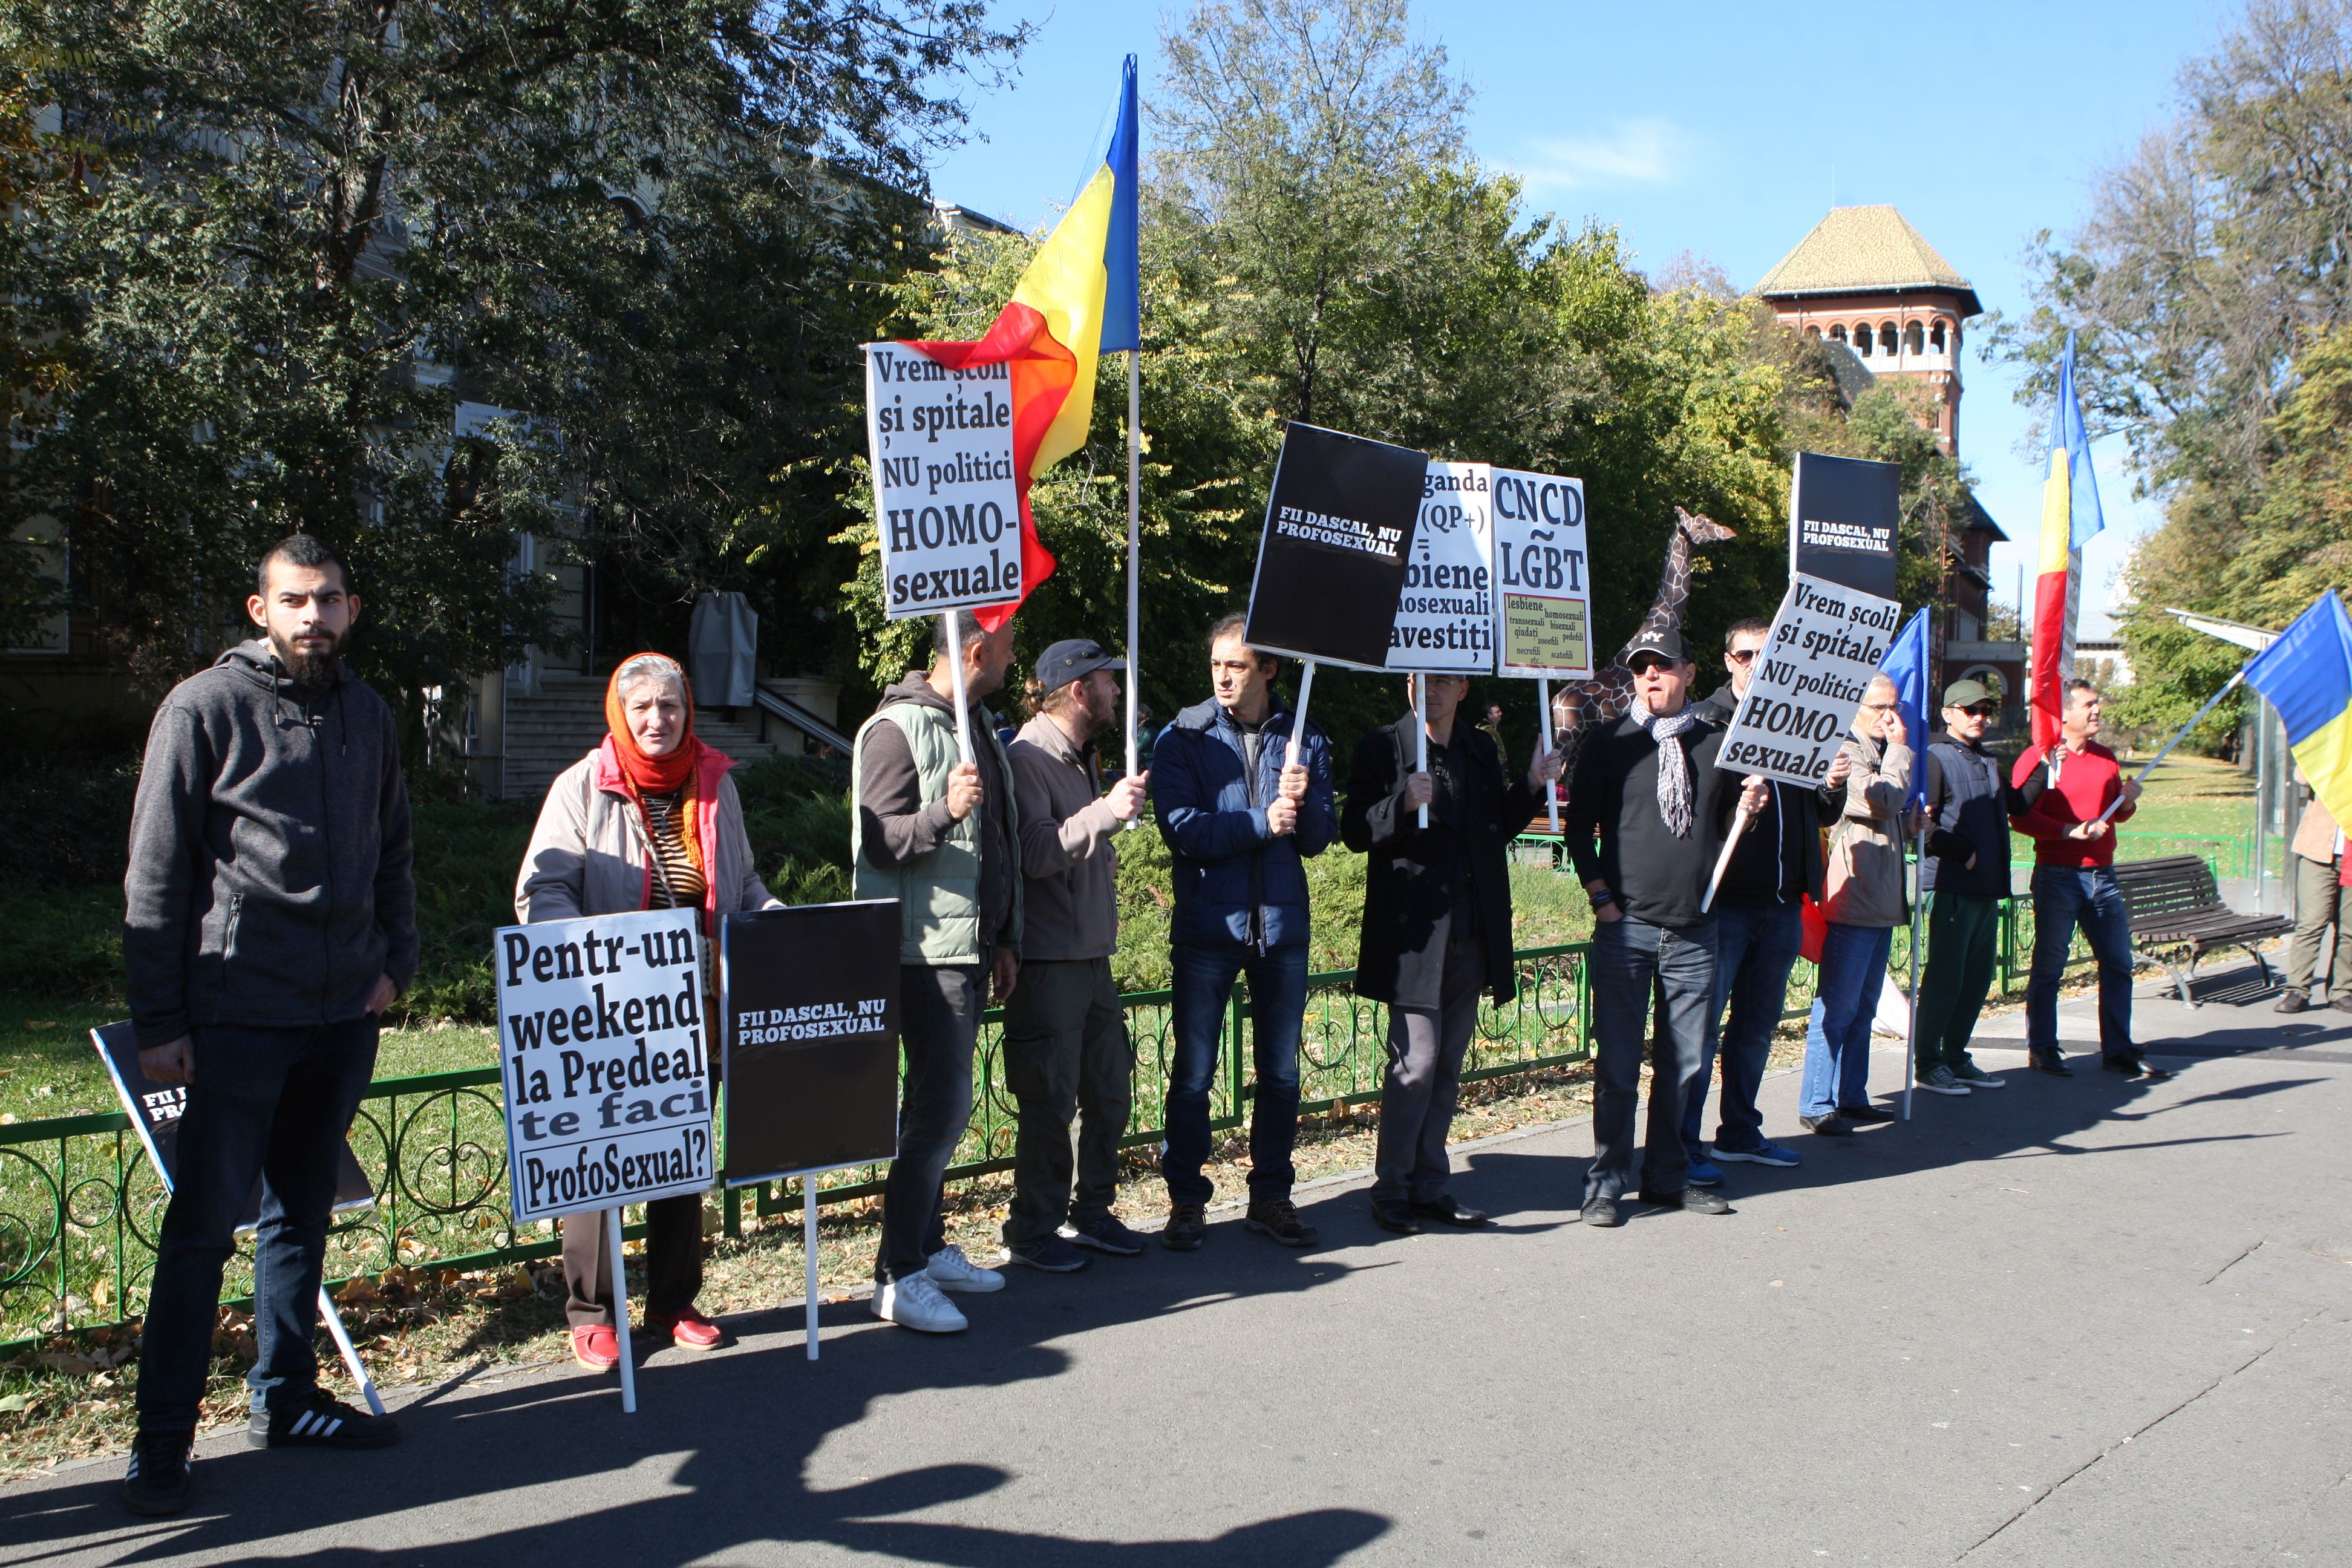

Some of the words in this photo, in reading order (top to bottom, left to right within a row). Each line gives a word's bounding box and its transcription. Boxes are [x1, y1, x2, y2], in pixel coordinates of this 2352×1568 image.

[874, 351, 947, 383] Vrem
[879, 394, 905, 449] și
[913, 391, 1010, 443] spitale
[882, 456, 920, 488] NU
[927, 449, 1013, 495] politici
[1495, 476, 1583, 527] CNCD
[887, 501, 1018, 553] HOMO-
[1276, 520, 1397, 557] PROFOSEXUAL
[1279, 506, 1303, 522] FII
[1305, 511, 1374, 540] DASCAL,
[1377, 526, 1402, 543] NU
[1803, 520, 1820, 532] FII
[1821, 521, 1871, 540] DASCAL,
[1872, 528, 1890, 540] NU
[1803, 532, 1889, 552] PROFOSEXUAL
[893, 548, 1019, 605] sexuale
[1500, 541, 1584, 592] LGBT
[1507, 595, 1543, 612] lesbiene
[1544, 608, 1584, 621] homosexuali
[1794, 583, 1846, 619] Vrem
[1847, 606, 1897, 632] școli
[1509, 616, 1545, 627] transsexuali
[1550, 619, 1576, 631] bisexuali
[1563, 632, 1584, 643] pedofili
[1640, 630, 1665, 643] NY
[1774, 617, 1803, 654] și
[1802, 627, 1883, 666] spitale
[1517, 646, 1541, 656] necrofili
[1551, 650, 1573, 659] scatofili
[1759, 658, 1797, 686] NU
[1791, 671, 1867, 704] politici
[1741, 696, 1845, 743] HOMO-
[1725, 741, 1830, 780] sexuale
[503, 927, 696, 987] Pentr-un
[508, 970, 701, 1052] weekend
[738, 1010, 765, 1028] FII
[769, 1002, 854, 1025] DASCAL,
[857, 998, 886, 1016] NU
[738, 1016, 885, 1046] PROFOSEXUAL
[511, 1054, 552, 1106] la
[559, 1028, 705, 1099] Predeal
[142, 1089, 176, 1108] FII
[517, 1109, 580, 1142] te
[598, 1080, 708, 1130] faci
[526, 1128, 707, 1208] ProfoSexual?
